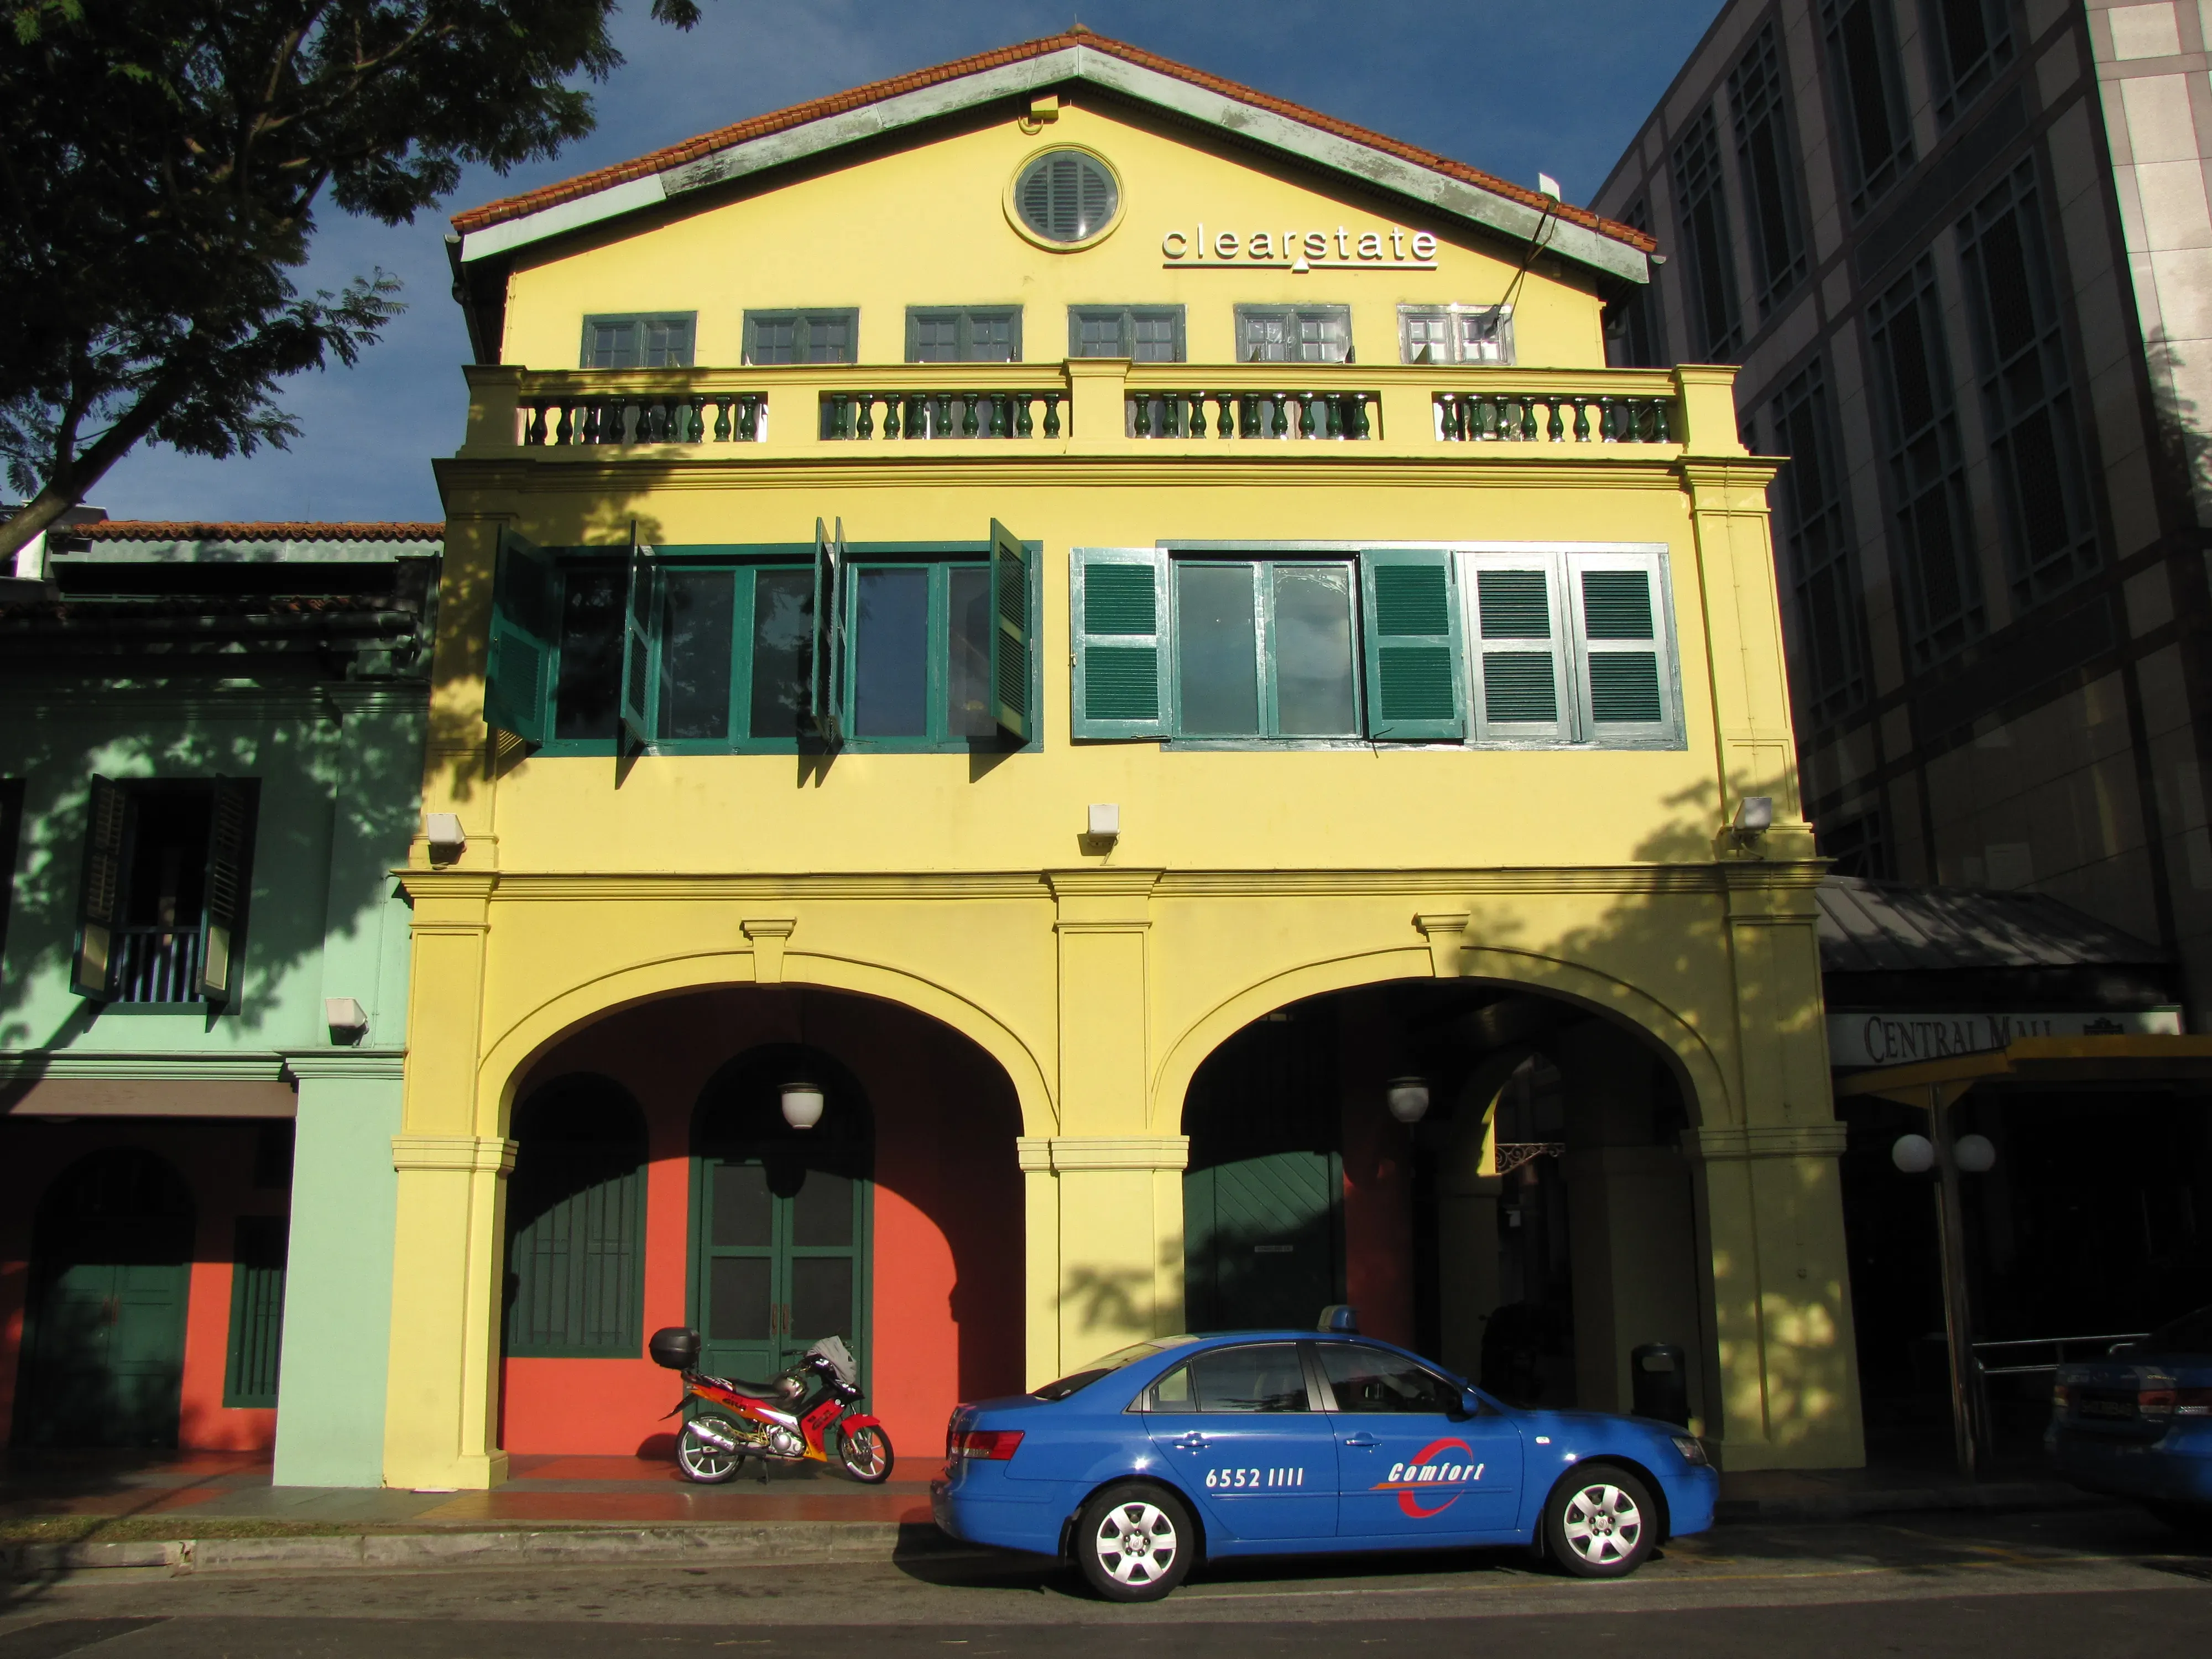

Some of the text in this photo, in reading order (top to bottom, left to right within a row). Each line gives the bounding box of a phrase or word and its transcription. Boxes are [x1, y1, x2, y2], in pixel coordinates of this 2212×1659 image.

[1162, 223, 1437, 260] clearstate
[1864, 1016, 1975, 1063] CENTRAL
[1206, 1468, 1260, 1488] 6552
[1387, 1462, 1485, 1482] Comfort
